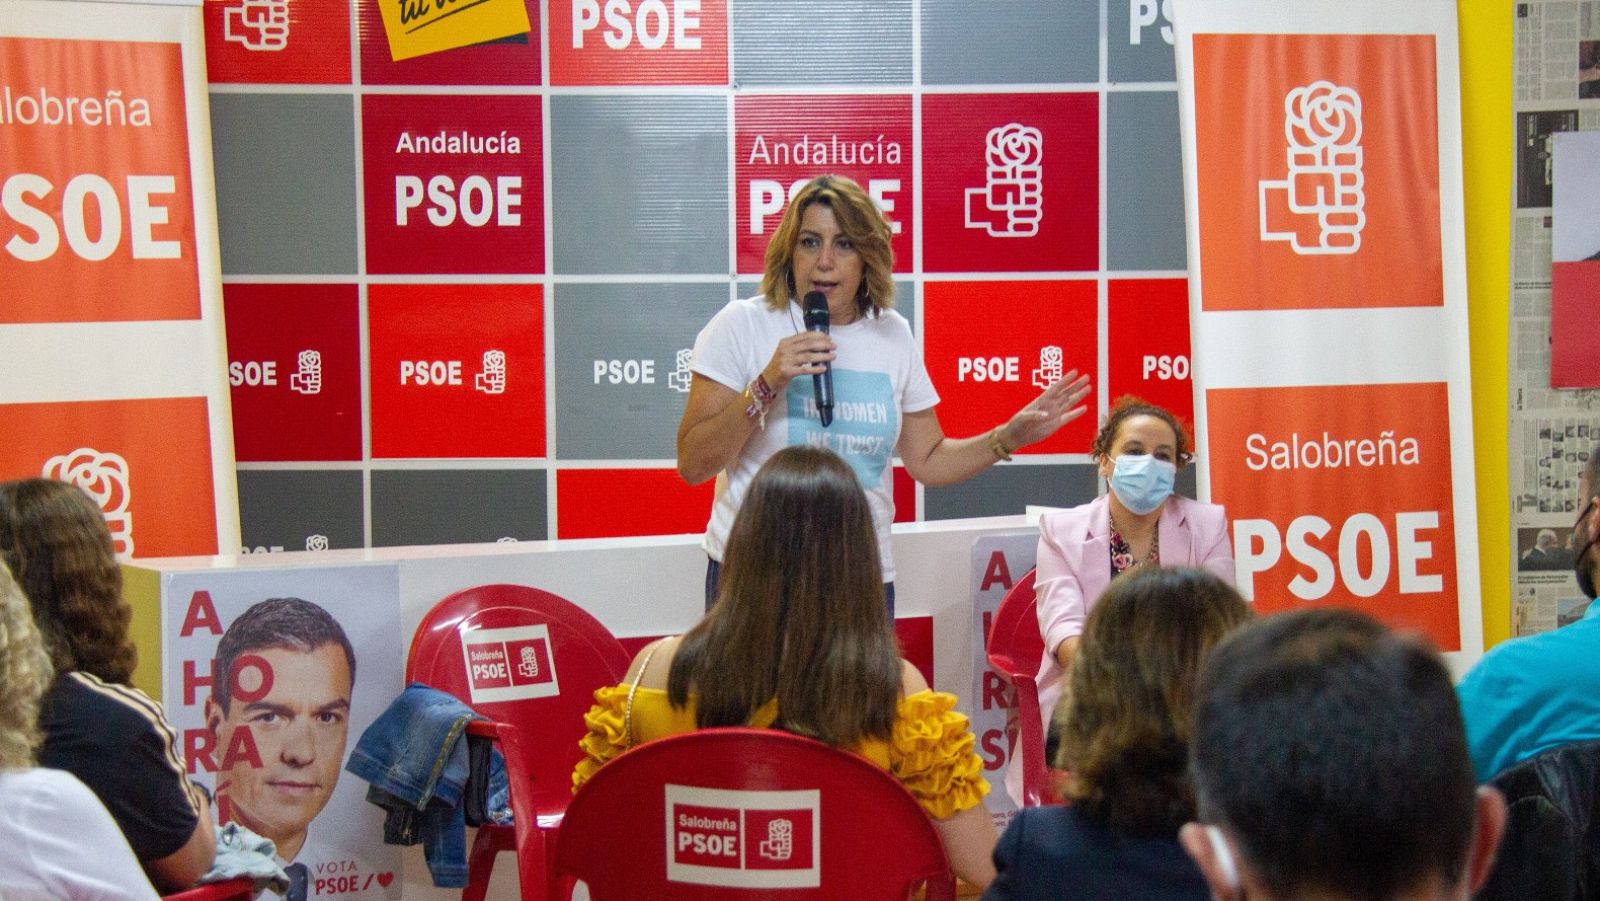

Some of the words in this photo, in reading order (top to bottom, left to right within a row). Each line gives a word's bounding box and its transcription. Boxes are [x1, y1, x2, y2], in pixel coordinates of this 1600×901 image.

[572, 0, 702, 50] PSOE
[395, 131, 522, 155] Andalucía
[748, 134, 902, 165] Andalucía
[395, 175, 522, 228] PSOE
[1, 173, 182, 262] SOE
[229, 361, 277, 387] SOE
[400, 360, 462, 386] PSOE
[593, 359, 655, 385] PSOE
[957, 356, 1019, 382] PSOE
[1142, 355, 1191, 381] PSO
[1245, 430, 1420, 471] Salobreña
[1233, 510, 1444, 601] PSOE
[180, 590, 224, 637] A
[183, 655, 275, 706] HO
[473, 663, 507, 680] PSOE
[679, 813, 737, 832] Salobreña
[678, 831, 737, 857] PSOE
[316, 861, 357, 874] VOTA
